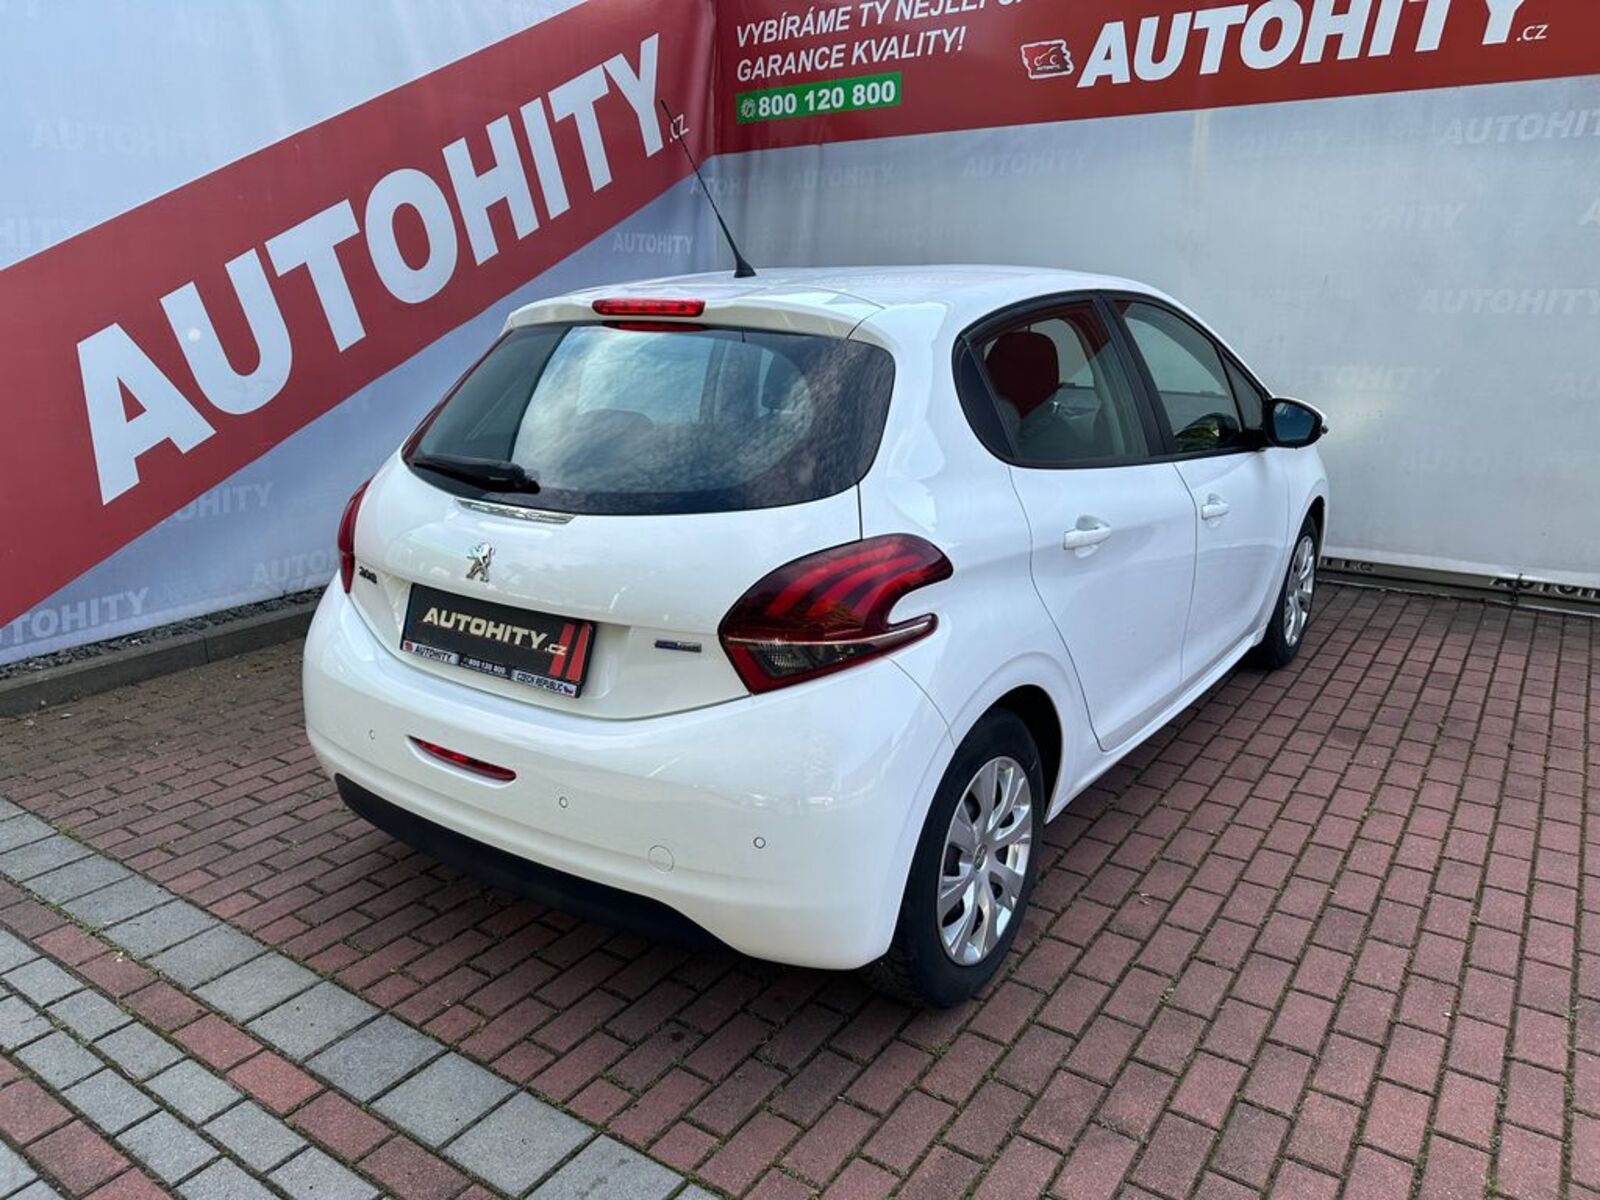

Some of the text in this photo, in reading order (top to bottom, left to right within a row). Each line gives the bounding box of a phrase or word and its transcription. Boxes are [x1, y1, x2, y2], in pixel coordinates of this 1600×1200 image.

[736, 6, 851, 48] VYBÍRÁME
[859, 1, 893, 28] TY
[737, 26, 966, 82] GARANCE KVALITY!
[758, 80, 896, 118] 800 120 800
[613, 231, 694, 256] AUTOHITY
[250, 547, 338, 590] AUTO
[0, 587, 149, 643] TOHITY
